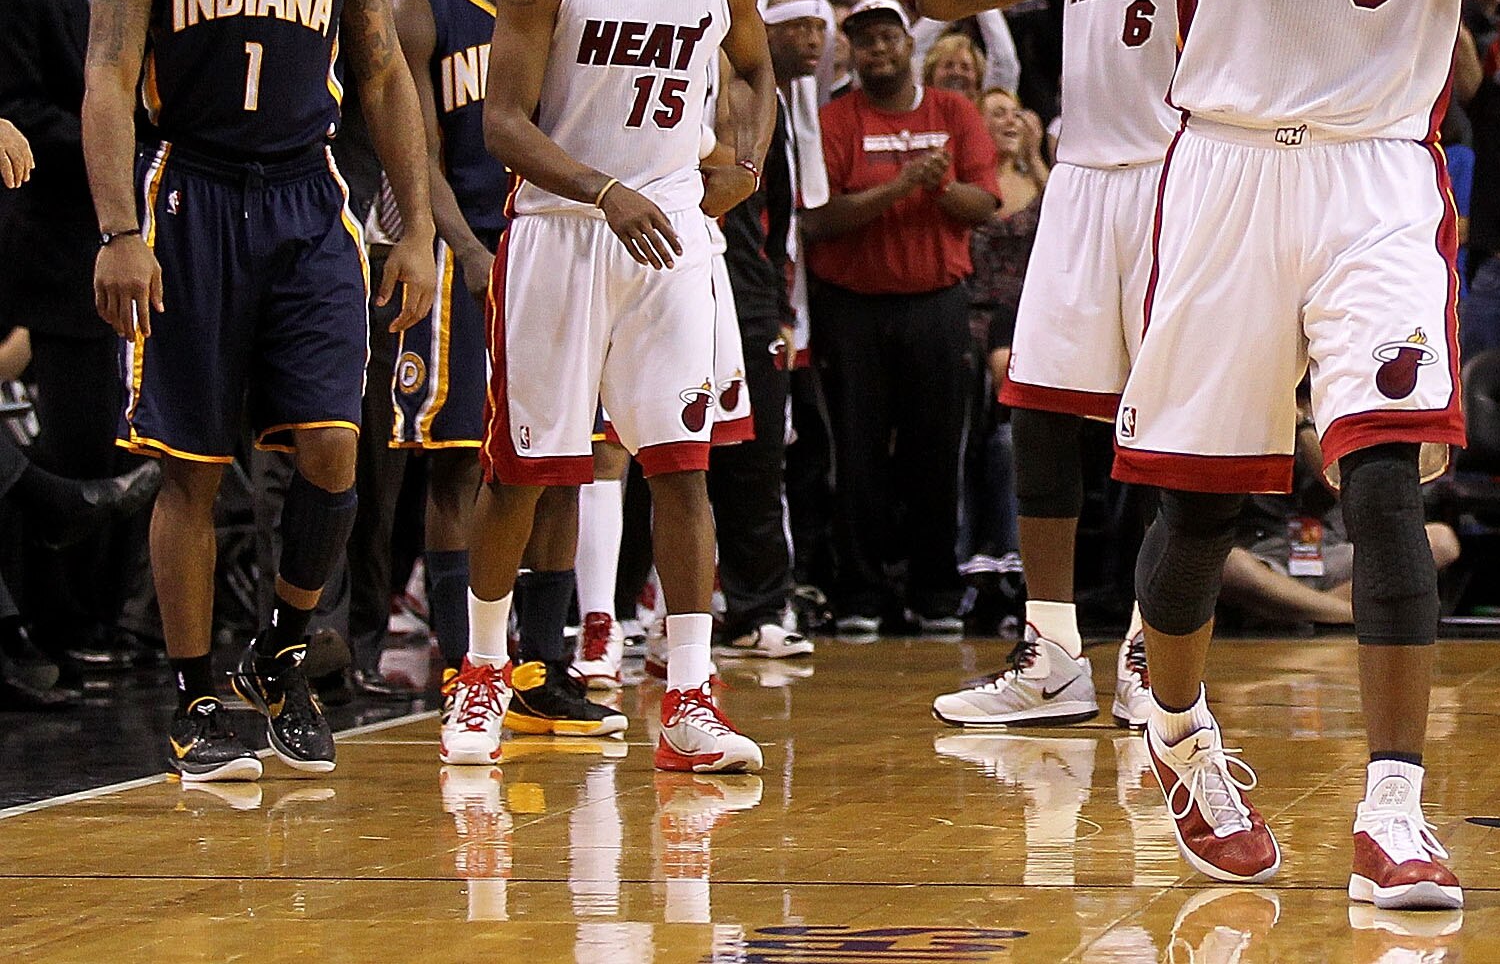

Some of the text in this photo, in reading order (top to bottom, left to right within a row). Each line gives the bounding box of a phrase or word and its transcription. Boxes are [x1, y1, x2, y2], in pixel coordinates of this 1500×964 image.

[576, 11, 713, 70] HEAT
[243, 41, 264, 111] 1
[624, 75, 690, 130] 15
